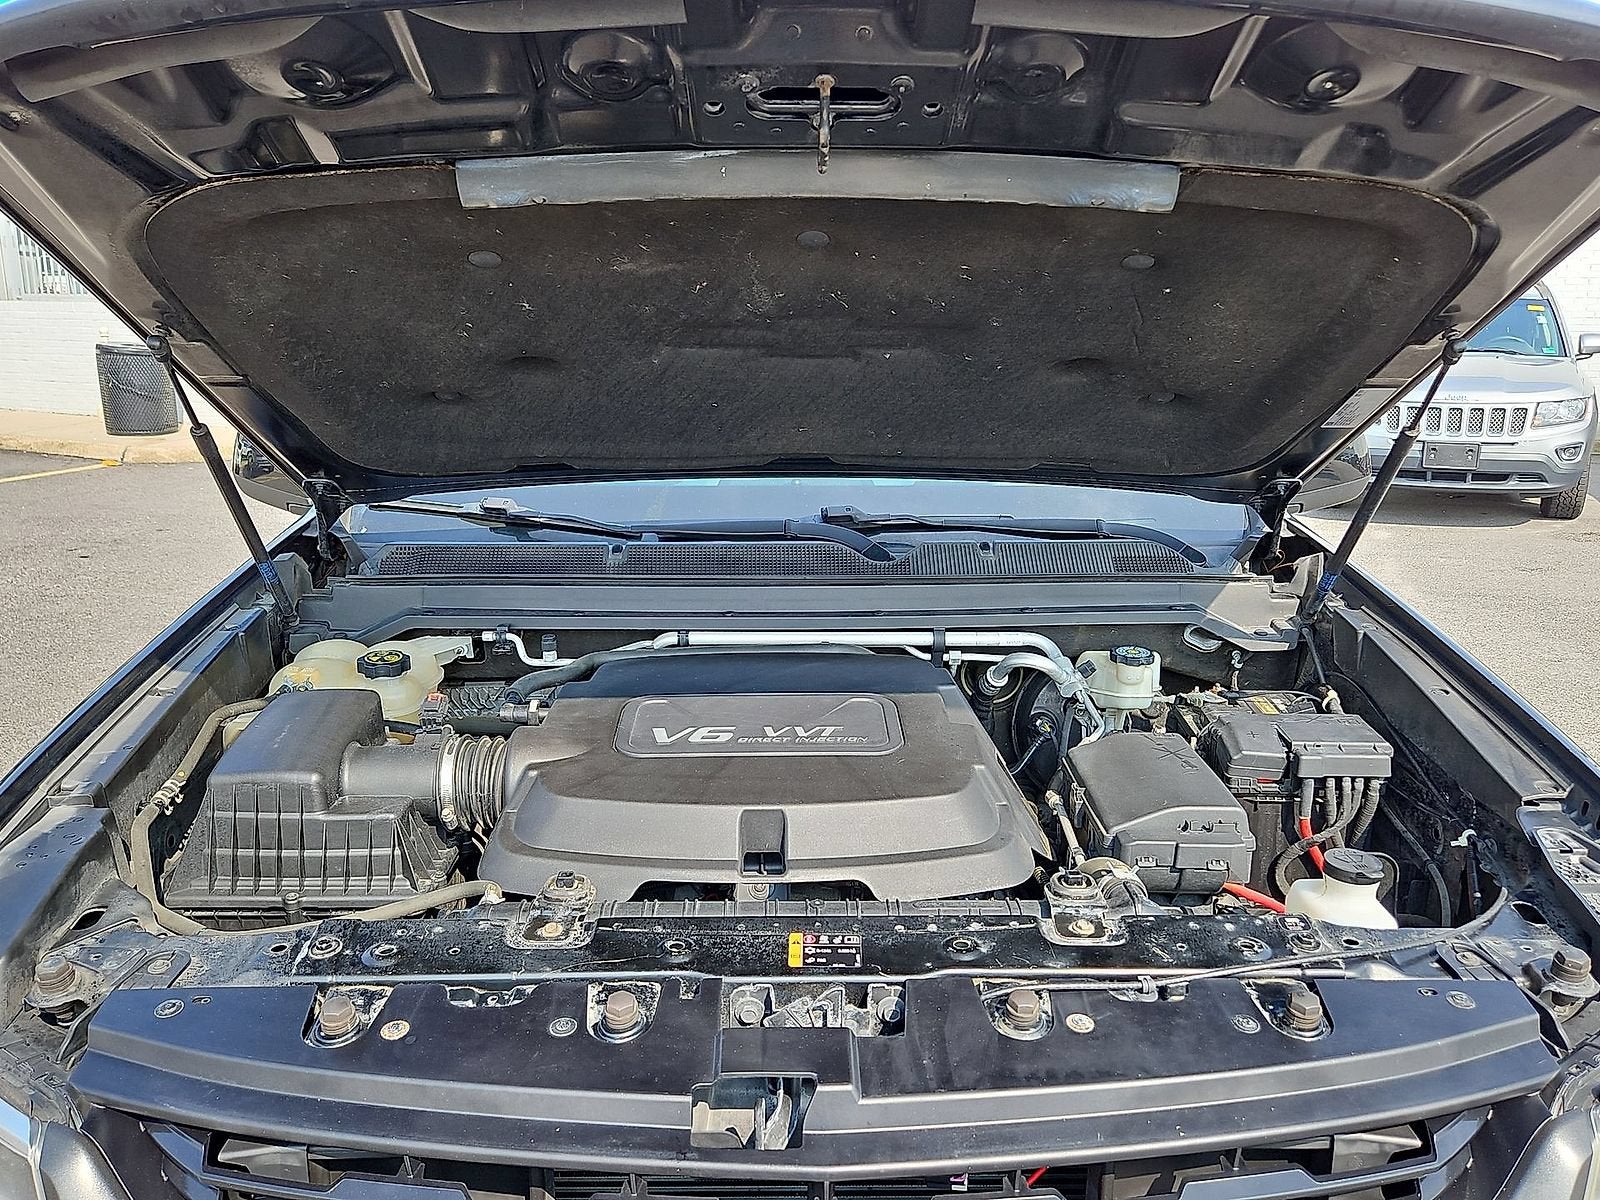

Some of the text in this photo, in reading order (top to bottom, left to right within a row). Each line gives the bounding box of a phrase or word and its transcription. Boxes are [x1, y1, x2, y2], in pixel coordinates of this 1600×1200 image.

[1447, 393, 1467, 402] Jeep
[651, 725, 844, 744] V6 VVT
[737, 736, 868, 744] DIRECT INJECTION
